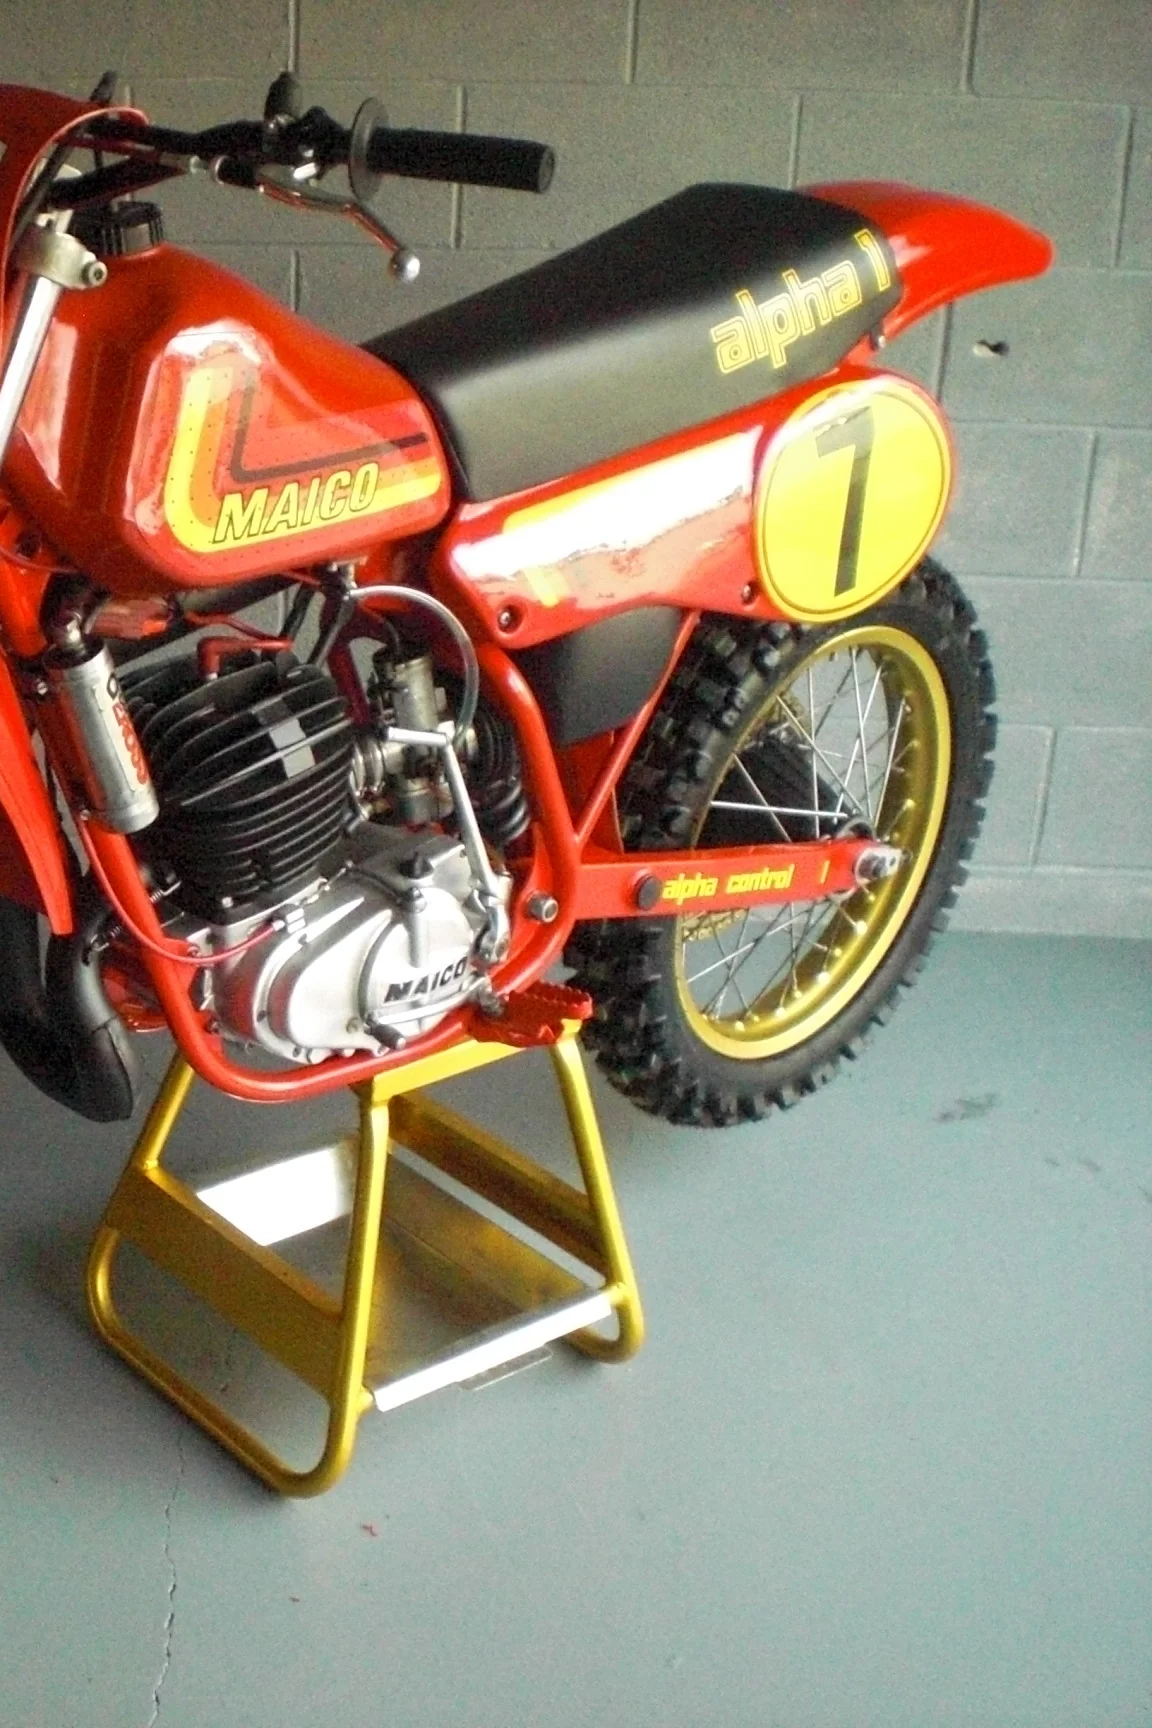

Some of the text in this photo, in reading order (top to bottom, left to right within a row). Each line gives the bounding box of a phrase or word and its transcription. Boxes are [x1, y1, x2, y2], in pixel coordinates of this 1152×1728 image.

[710, 268, 863, 374] alpha
[211, 461, 380, 545] MAICO
[812, 405, 875, 597] 7
[662, 872, 719, 906] alpha
[725, 863, 796, 894] control
[383, 956, 468, 1003] MAICO
